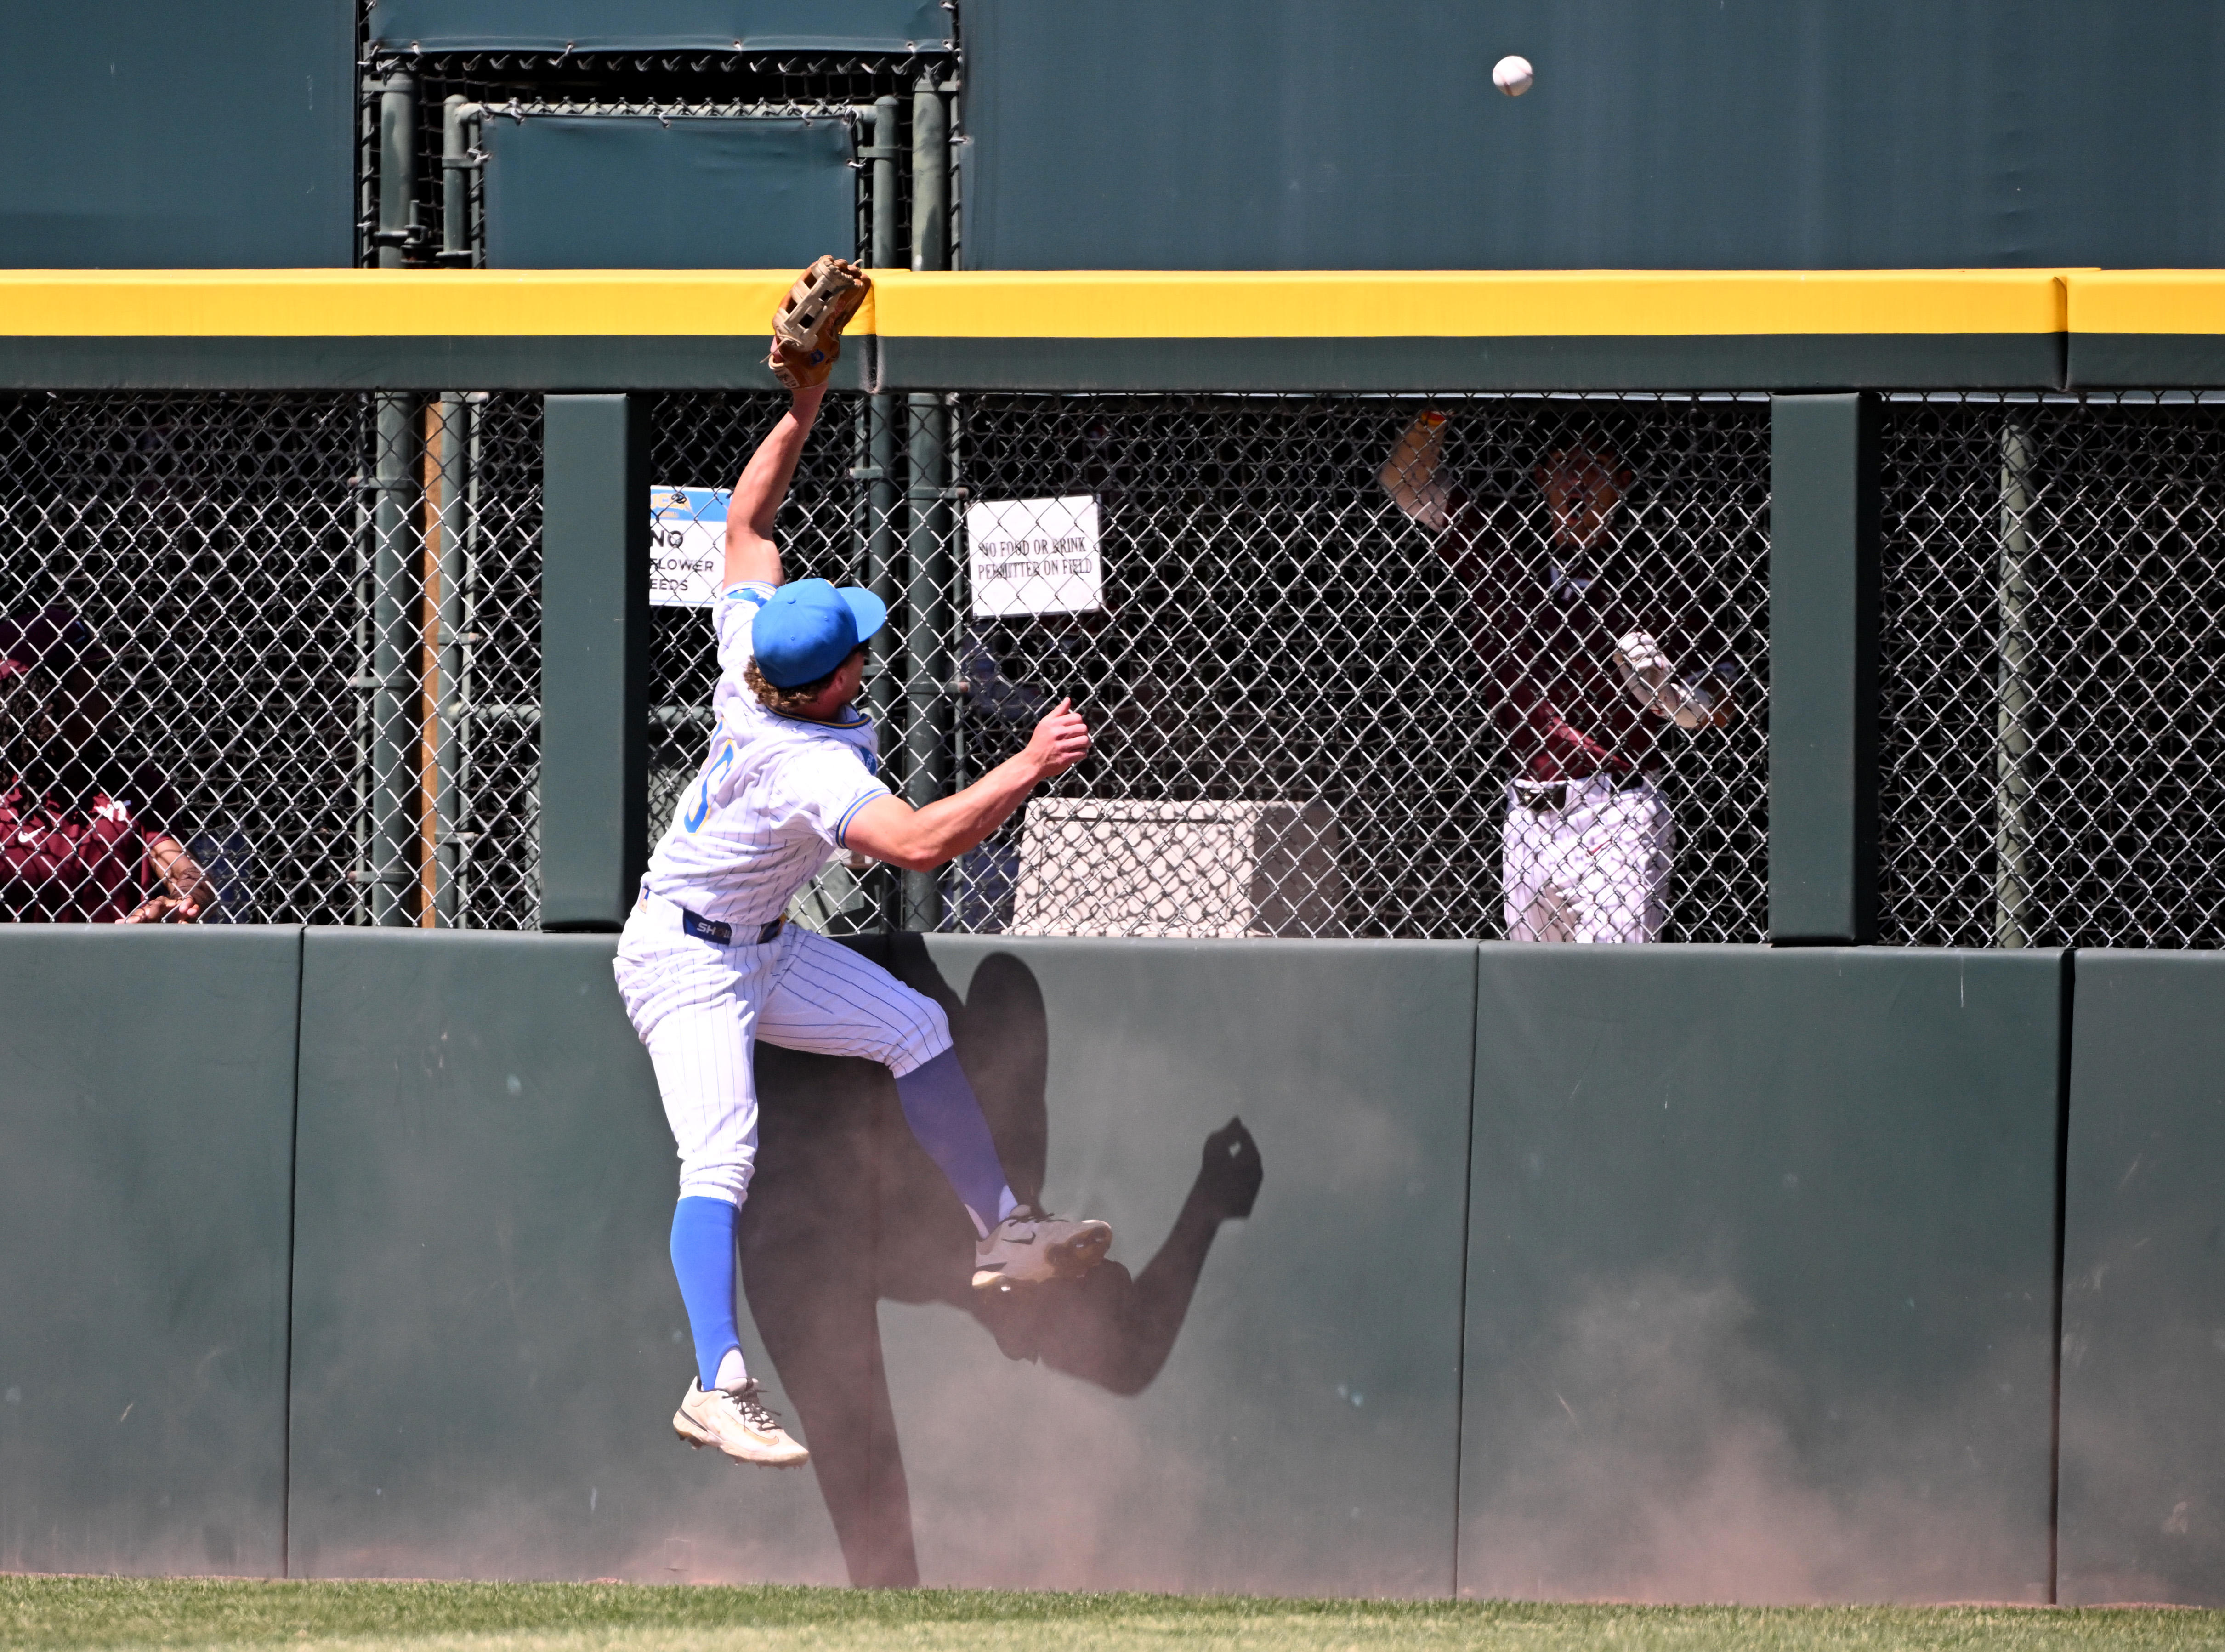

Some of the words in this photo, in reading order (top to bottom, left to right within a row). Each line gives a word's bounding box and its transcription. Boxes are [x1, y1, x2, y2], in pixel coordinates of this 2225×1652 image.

[651, 530, 683, 548] NO
[981, 542, 996, 557] NO
[1000, 540, 1029, 557] FOOD
[1034, 539, 1048, 555] OR
[651, 558, 714, 572] FLOWER
[1044, 560, 1058, 575] ON
[1063, 558, 1092, 574] FIELD
[650, 578, 688, 591] EEDS
